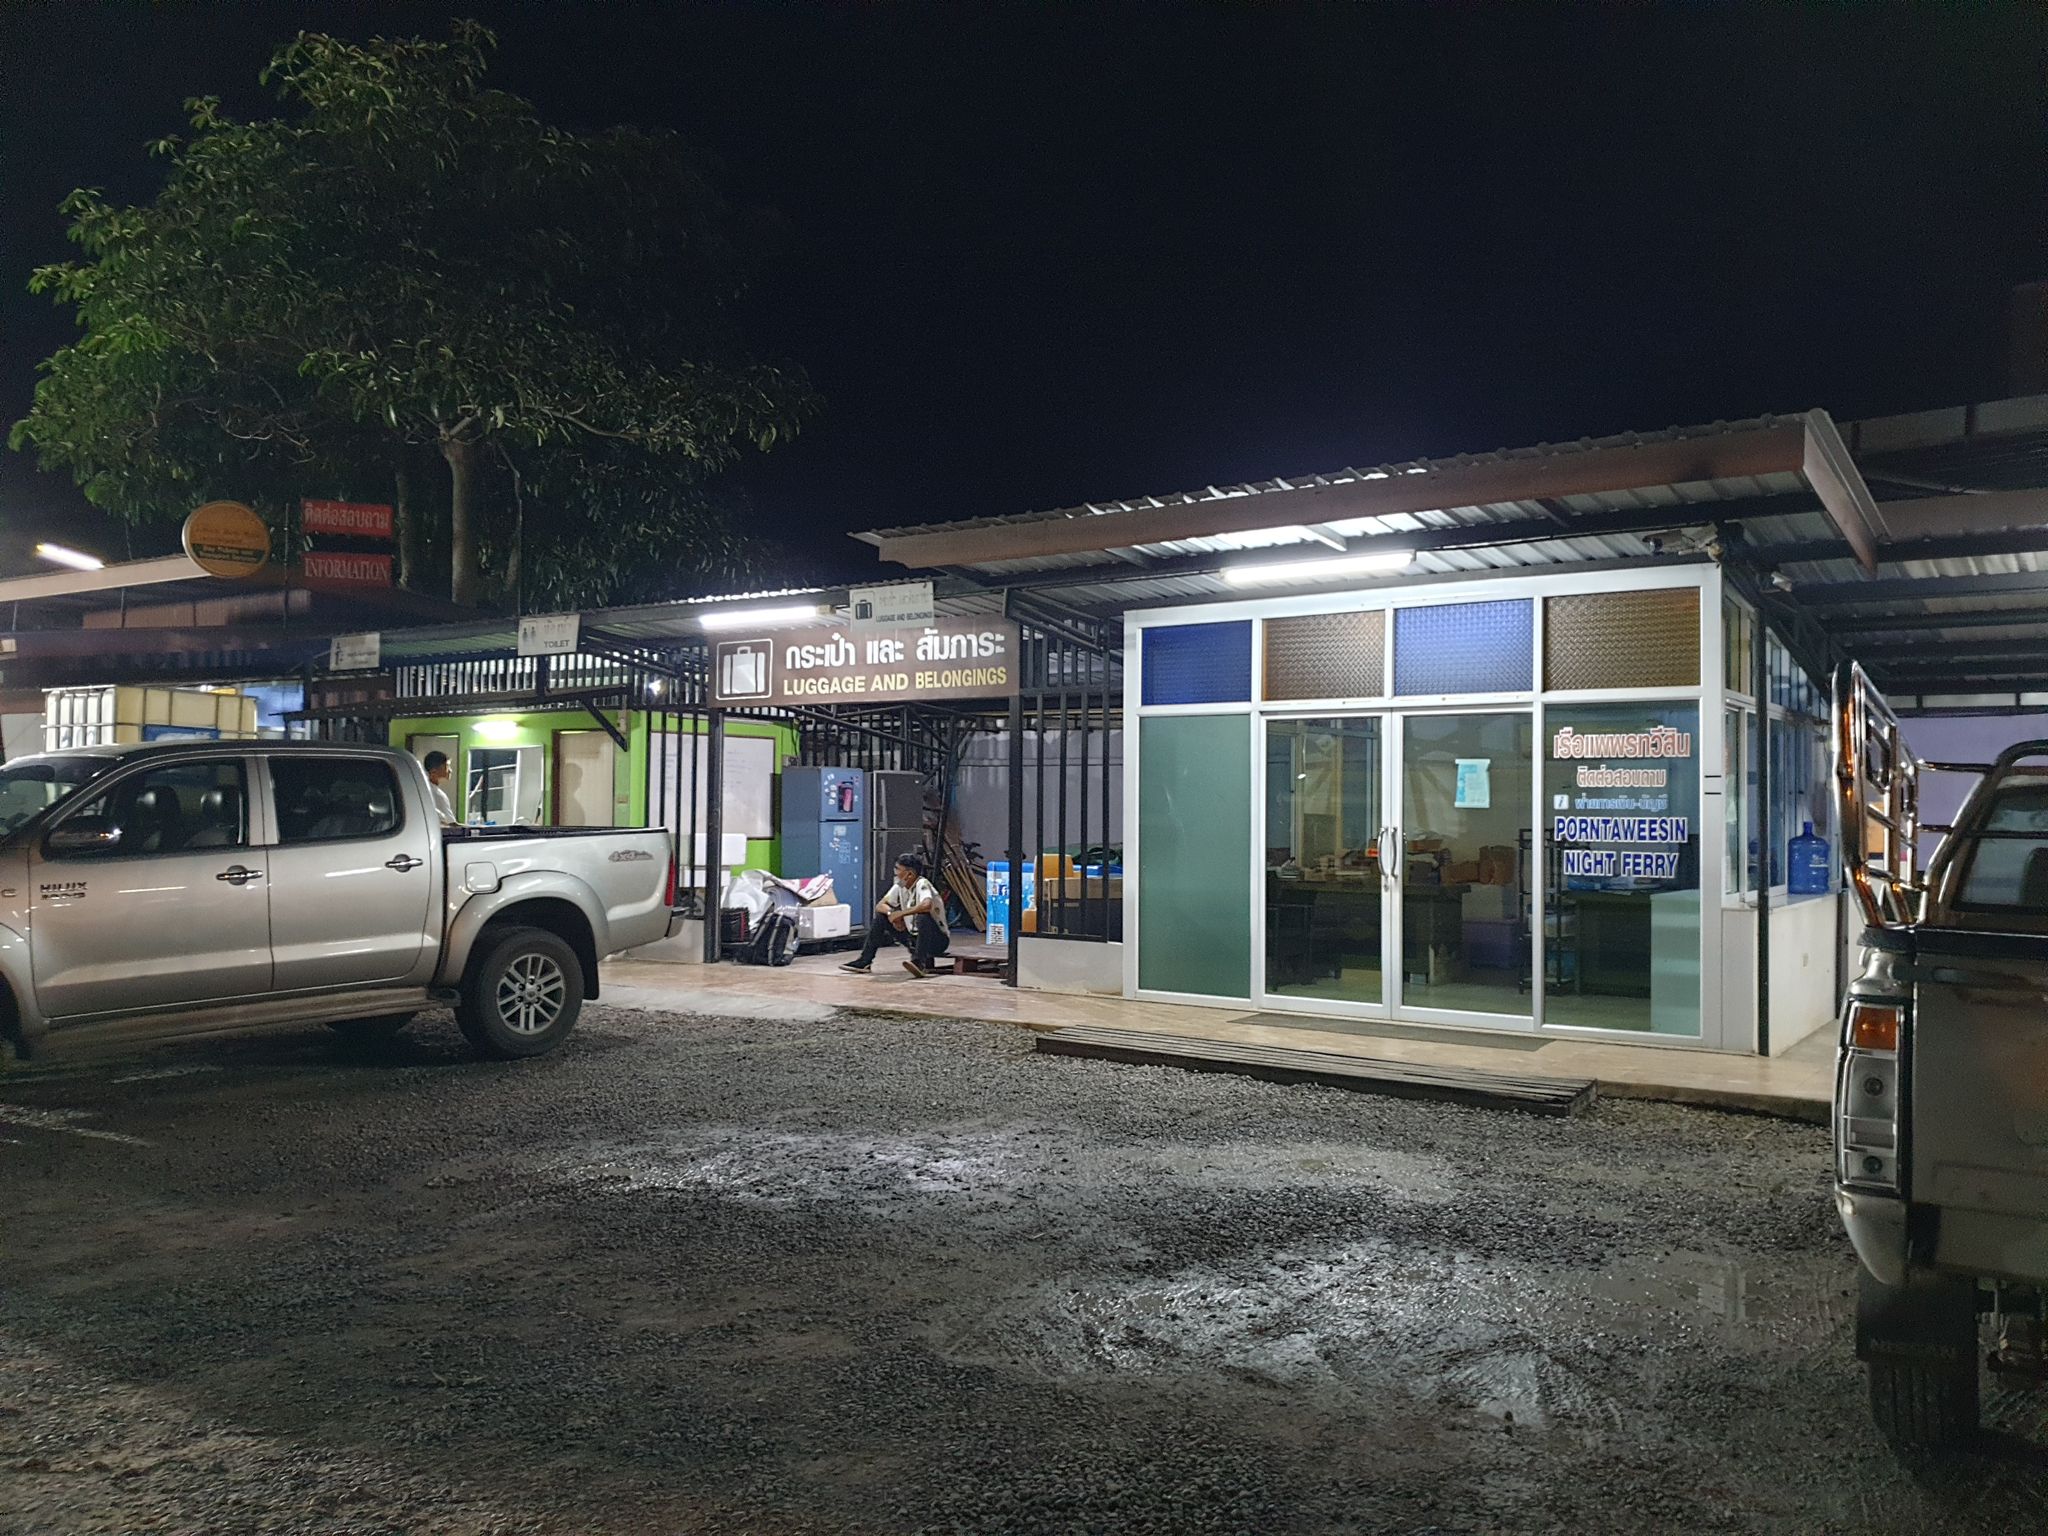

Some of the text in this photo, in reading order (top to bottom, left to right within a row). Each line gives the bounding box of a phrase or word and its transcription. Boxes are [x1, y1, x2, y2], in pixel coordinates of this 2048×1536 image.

[304, 502, 389, 530] ติดต่อสอบถาม
[304, 557, 389, 580] INFORMATION
[543, 639, 570, 649] TOILET
[785, 628, 1005, 670] กระเป๋า และ สัมภาระ
[783, 666, 1008, 696] LUGGAGE AND BELONGINGS
[1553, 725, 1691, 759] เรือแพพรทวีสิน
[1577, 765, 1667, 787] ติดต่อสอบถาม
[1554, 816, 1688, 843] PORNTAWEESIN
[1564, 850, 1679, 878] NIGHT FERRY
